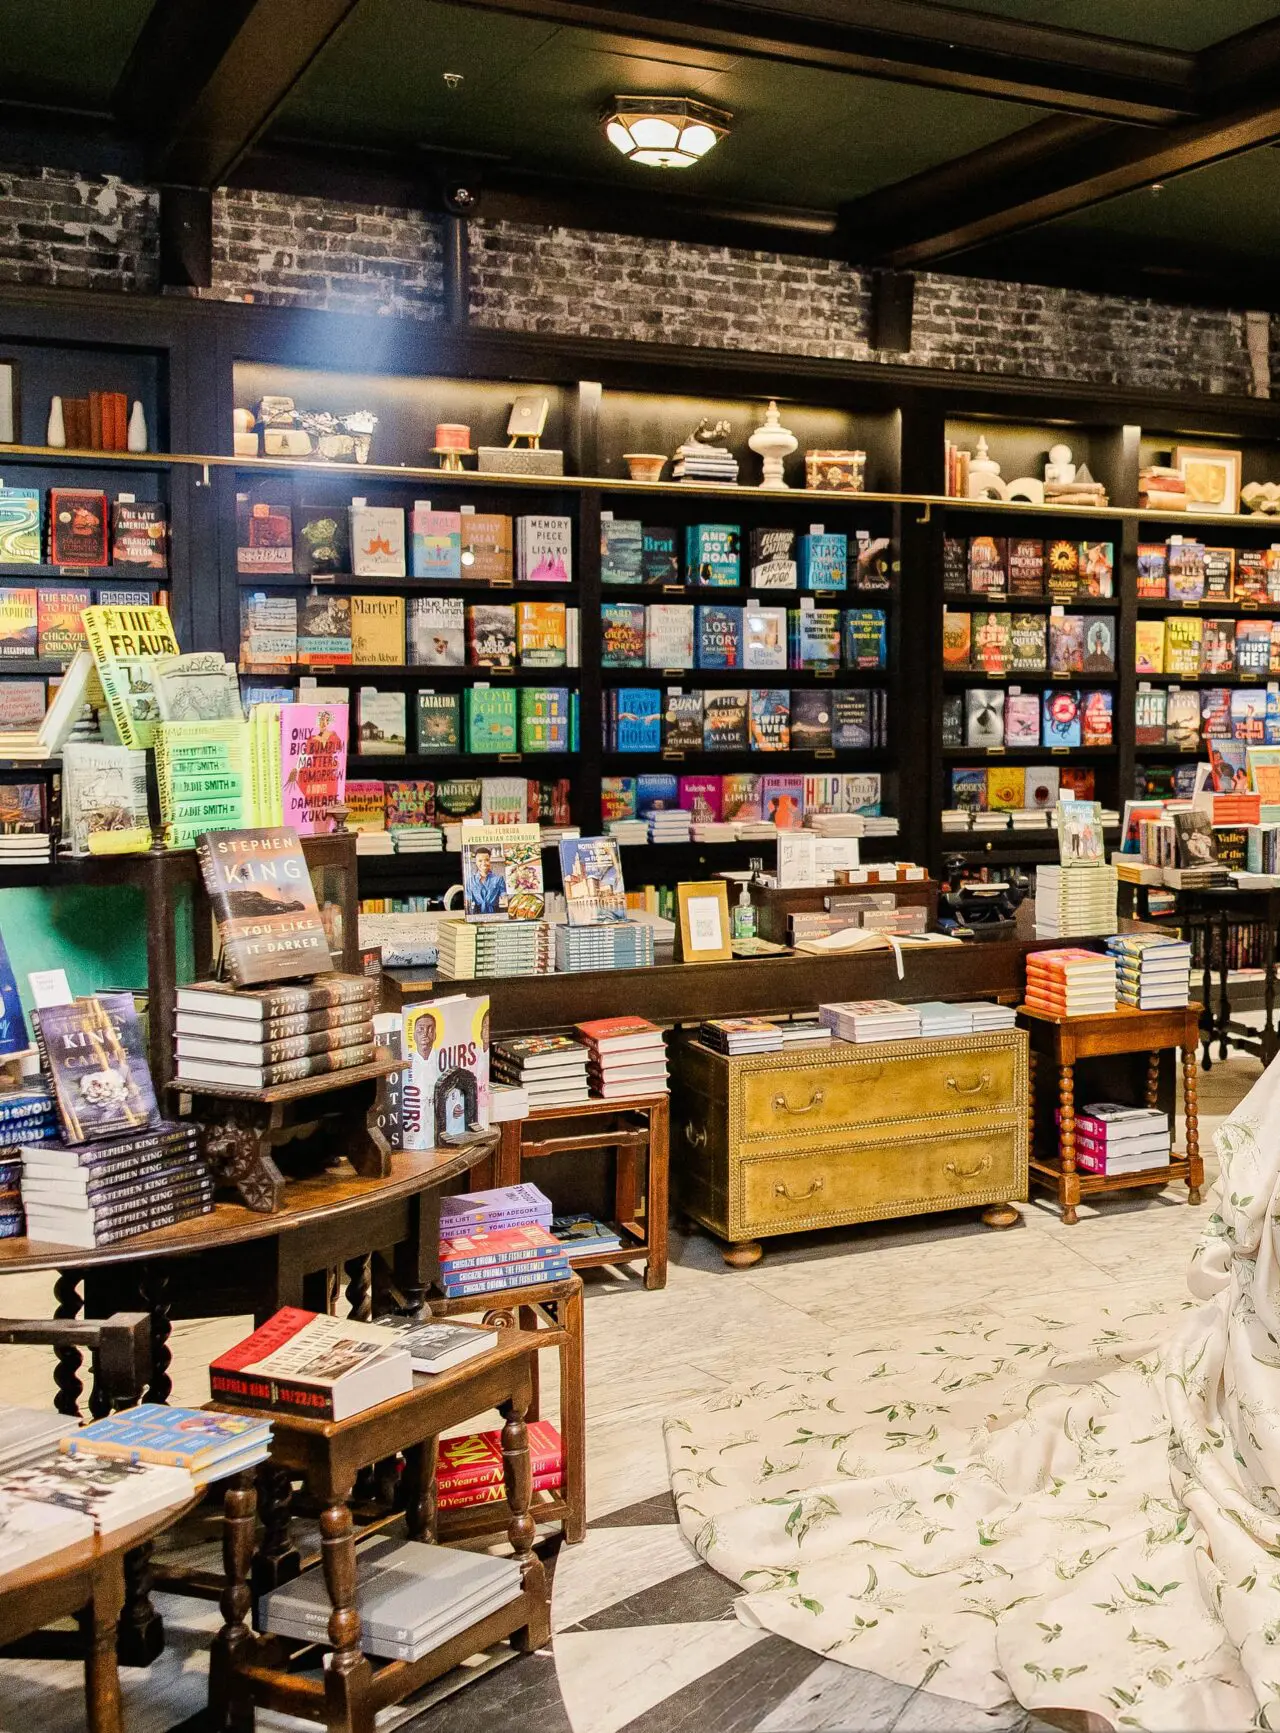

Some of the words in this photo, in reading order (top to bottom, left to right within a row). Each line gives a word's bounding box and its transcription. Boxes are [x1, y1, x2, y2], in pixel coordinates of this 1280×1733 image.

[530, 520, 568, 529] MEMORY
[536, 532, 563, 541] PIECE
[701, 531, 727, 541] AND
[531, 545, 553, 555] LISA
[643, 536, 673, 552] Brat
[704, 542, 721, 552] SO
[811, 544, 846, 558] STARS
[701, 553, 737, 564] ROAR
[354, 599, 399, 619] Martyr!
[605, 609, 632, 618] HARD
[115, 611, 156, 632] THE
[705, 622, 736, 633] LOST
[604, 631, 634, 640] GREAT
[701, 634, 739, 646] STORY
[1241, 643, 1268, 652] TRUST
[1239, 652, 1268, 667] HER
[668, 697, 702, 712] BURN
[716, 696, 737, 706] THE
[1136, 697, 1164, 711] JACK
[291, 727, 314, 741] ONLY
[709, 732, 741, 742] MADE
[289, 743, 307, 756] BIG
[298, 756, 339, 769] MATTERS
[766, 778, 783, 787] THE
[805, 776, 840, 798] HELP
[436, 784, 481, 796] ANDREW
[724, 792, 761, 802] LIMITS
[202, 804, 227, 815] SMITH
[301, 810, 328, 823] KUKU
[218, 837, 293, 853] STEPHEN
[1217, 832, 1248, 846] Valley
[224, 859, 302, 884] KING
[242, 922, 275, 936] YOU
[281, 918, 315, 932] LIKE
[246, 941, 263, 954] IT
[267, 937, 319, 952] DARKER
[270, 994, 305, 1006] STEPHEN
[270, 1003, 306, 1017] KING
[270, 1015, 305, 1028] STEPHEN
[270, 1024, 306, 1039] KING
[270, 1040, 305, 1052] STEPHEN
[270, 1049, 306, 1062] KING
[438, 1041, 477, 1073] OURS
[270, 1061, 305, 1074] STEPHEN
[270, 1070, 306, 1083] KING
[402, 1085, 421, 1132] OURS
[506, 1207, 538, 1216] ADEGOKE
[455, 1228, 471, 1236] LIST
[212, 1376, 248, 1397] STEPHEN
[438, 1479, 452, 1490] 50
[452, 1476, 478, 1487] Years
[480, 1472, 490, 1482] of
